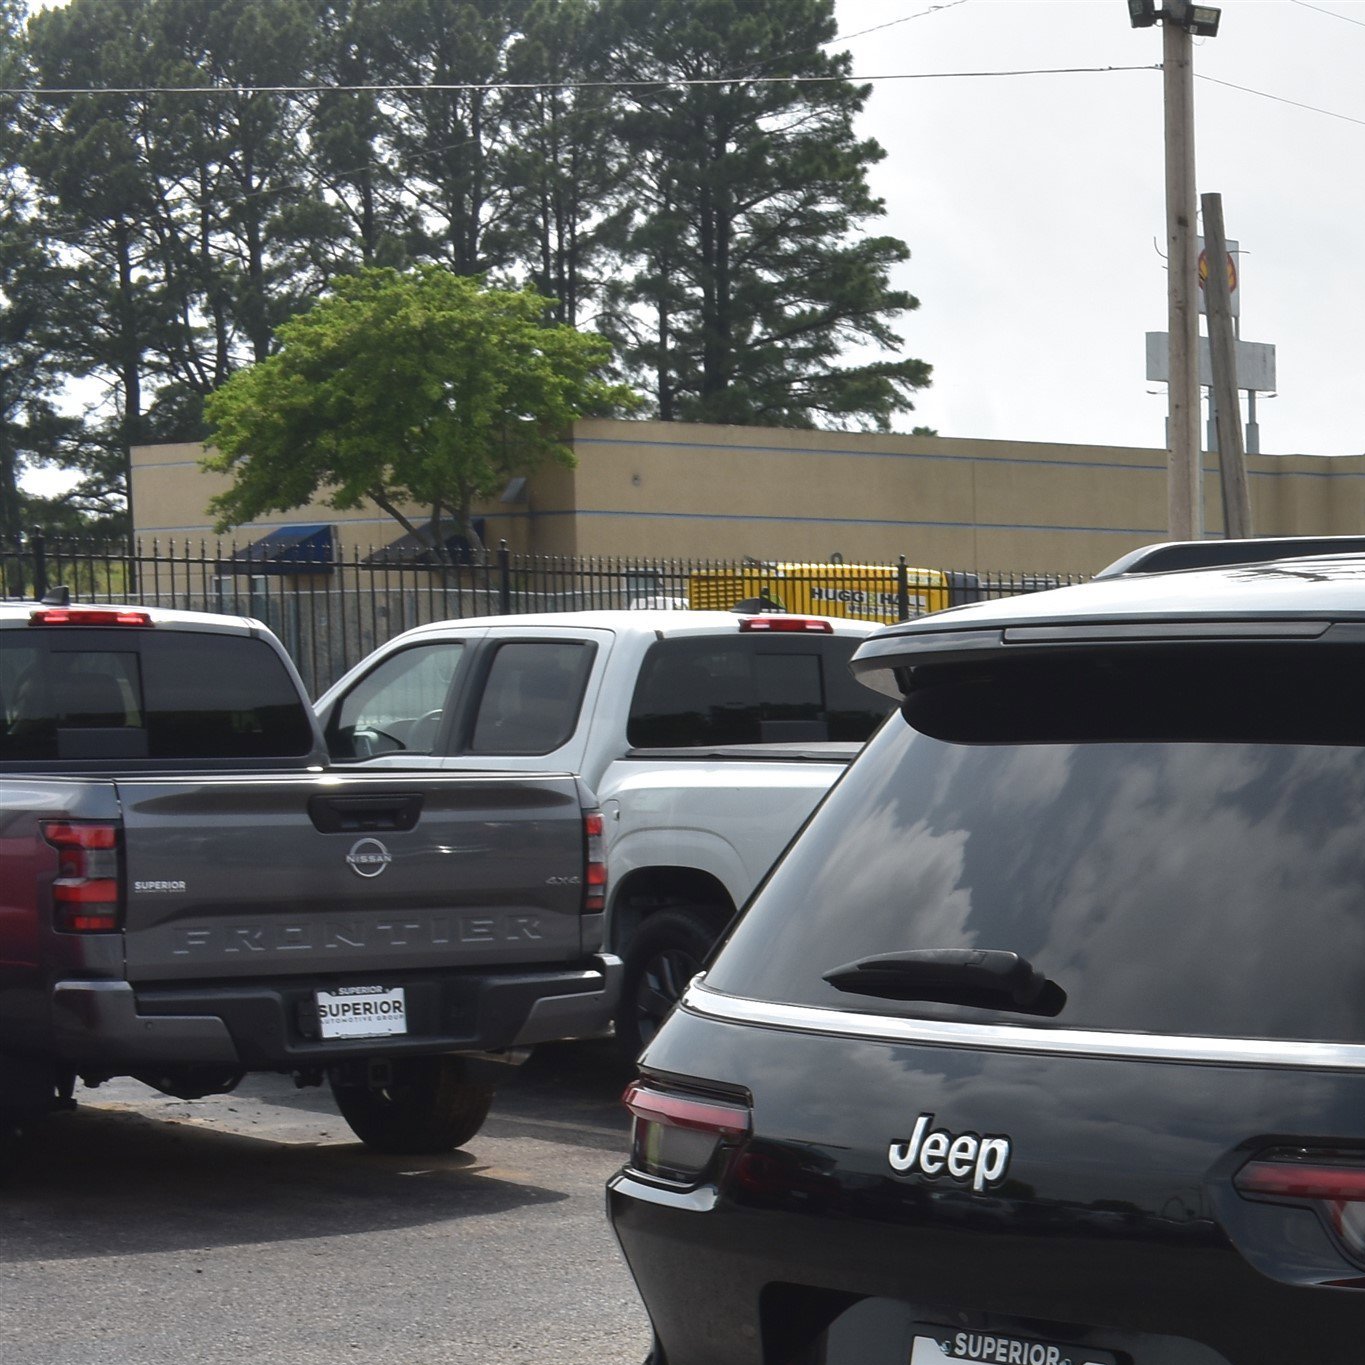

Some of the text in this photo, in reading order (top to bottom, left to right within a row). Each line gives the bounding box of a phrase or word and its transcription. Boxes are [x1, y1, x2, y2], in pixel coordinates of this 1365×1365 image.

[346, 854, 392, 864] NISSAN
[134, 881, 186, 890] SUPERIOR
[172, 914, 543, 956] FRONTIER
[338, 985, 383, 996] SUPERIOR
[319, 1000, 404, 1018] SUPERIOR
[888, 1115, 1010, 1192] Jeep
